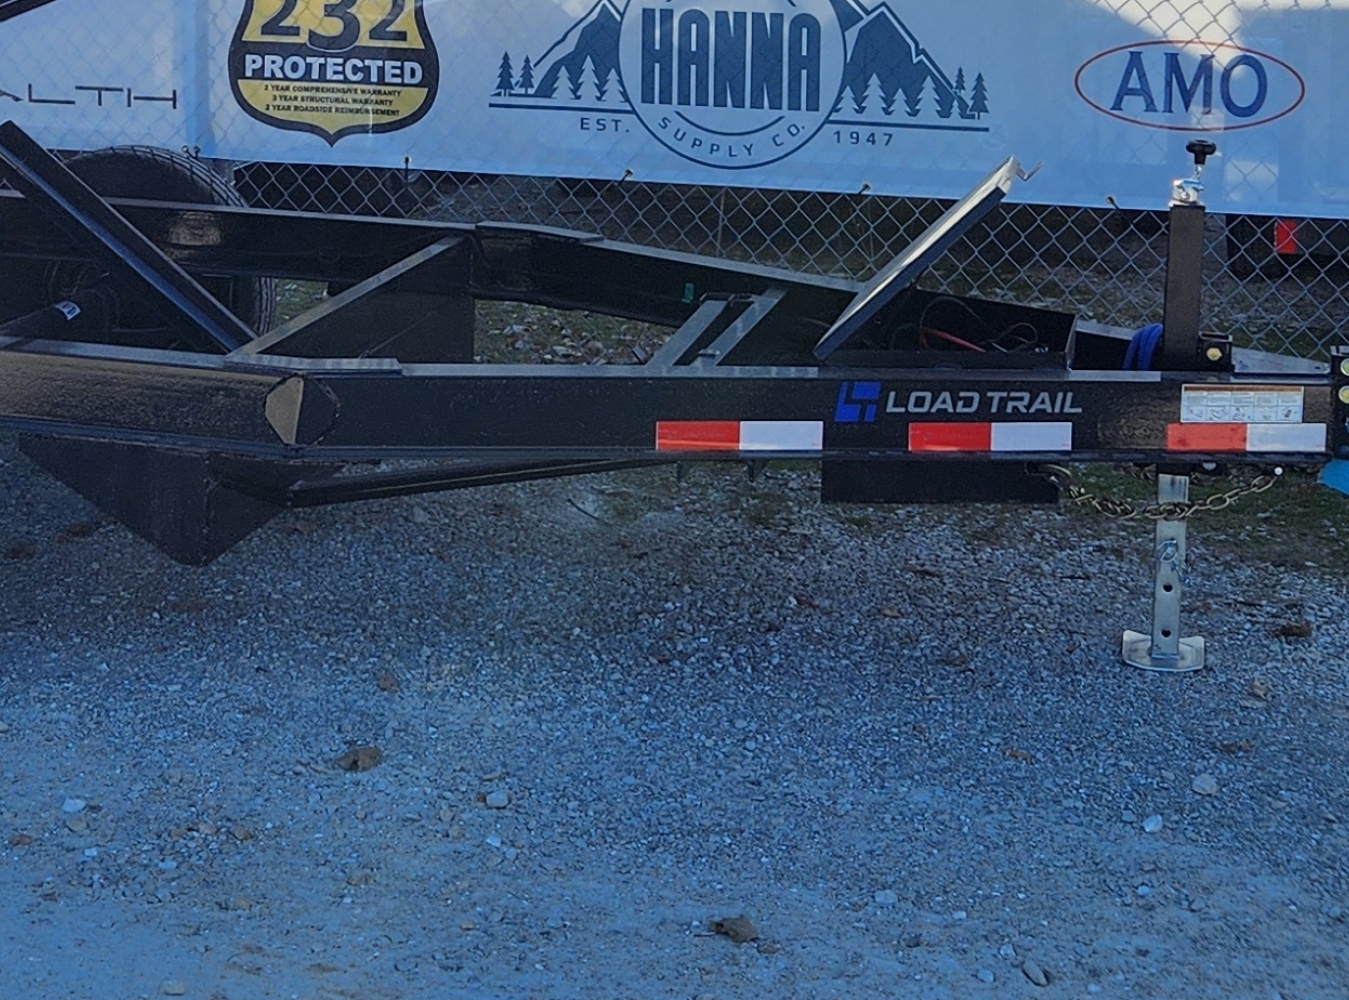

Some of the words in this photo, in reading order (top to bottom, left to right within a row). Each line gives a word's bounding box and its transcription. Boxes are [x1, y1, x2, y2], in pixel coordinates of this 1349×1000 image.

[244, 53, 424, 85] PROTECTED
[641, 8, 822, 113] HANNA
[292, 85, 359, 95] COMPREHENSIVE
[360, 89, 402, 97] WARRANTY
[1110, 50, 1268, 119] AMO
[272, 104, 292, 112] YEAR
[293, 105, 333, 113] ROADSIDE
[334, 107, 401, 117] REIMBURSEMENT
[301, 95, 350, 105] STRUCTURAL
[352, 98, 394, 106] WARRANTY
[579, 117, 631, 134] EST.
[657, 116, 754, 158] SUPPLY
[772, 123, 806, 148] CO.
[833, 130, 894, 147] 1947
[886, 391, 981, 414] LOAD
[986, 391, 1083, 414] TRAIL
